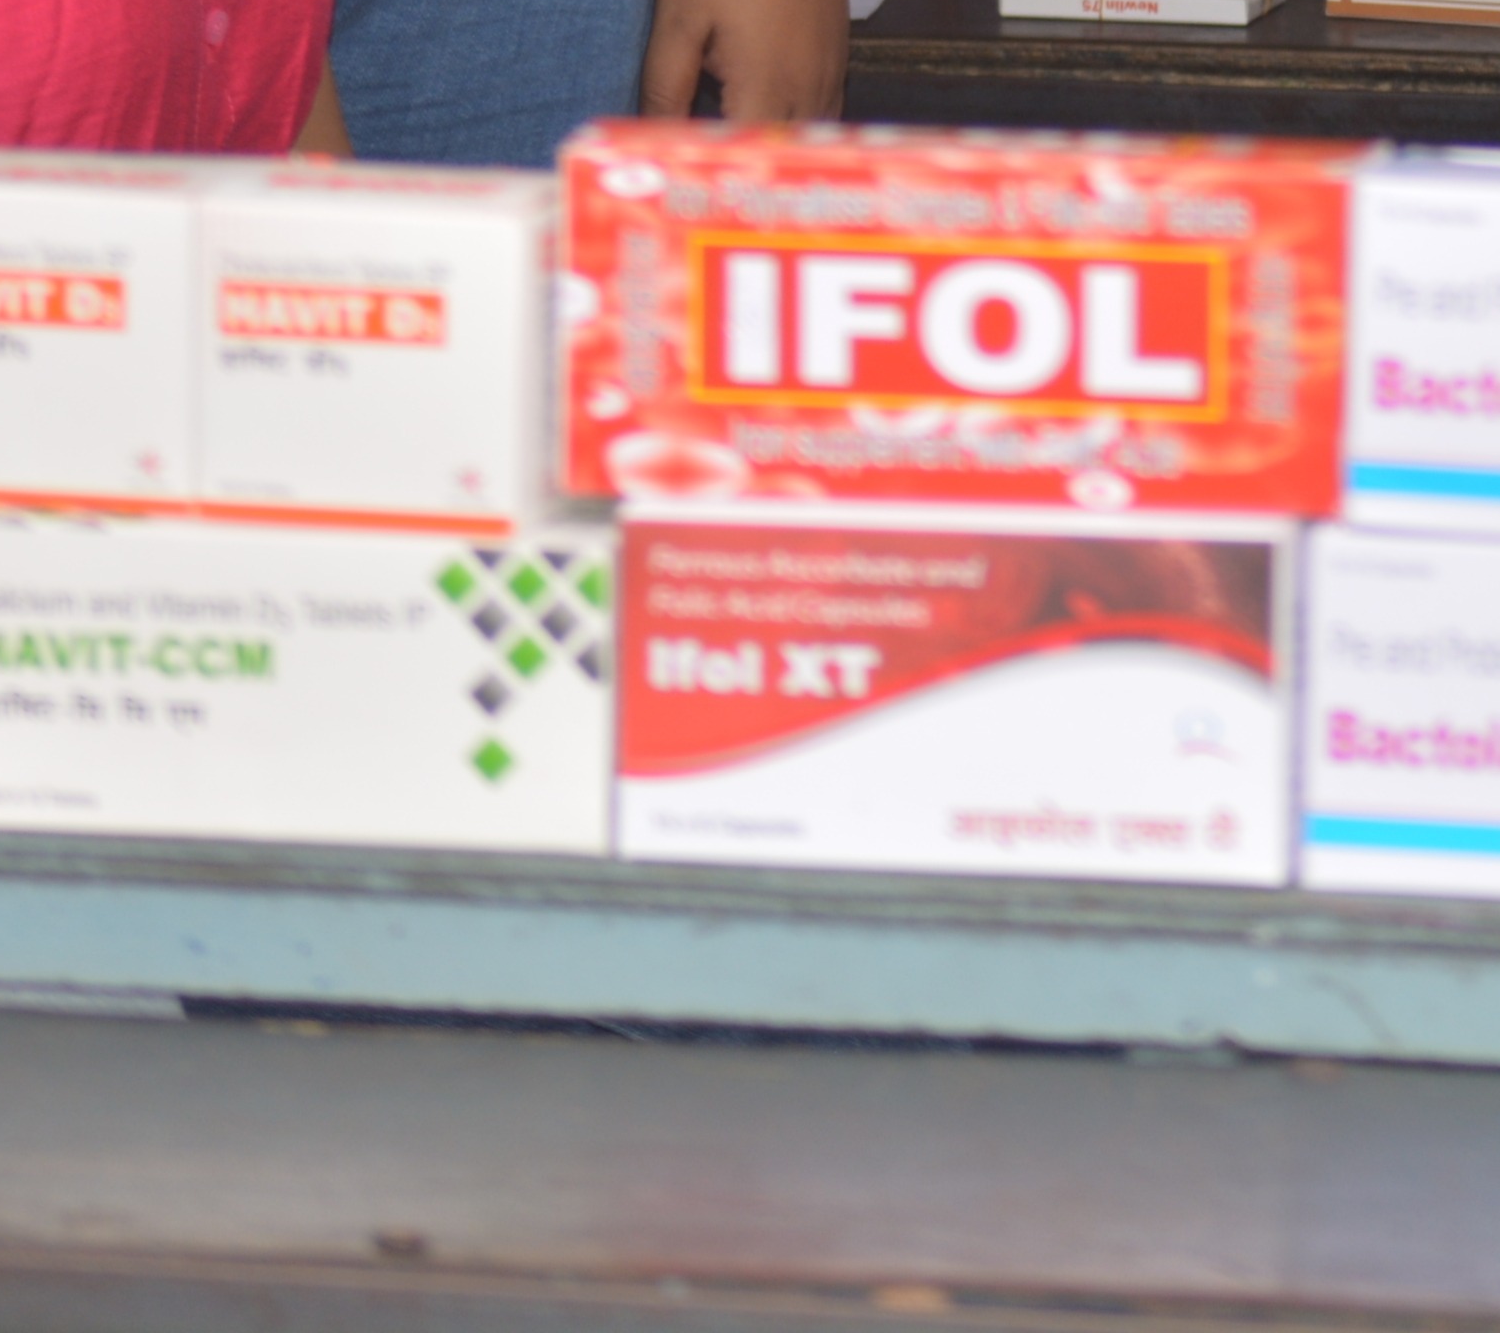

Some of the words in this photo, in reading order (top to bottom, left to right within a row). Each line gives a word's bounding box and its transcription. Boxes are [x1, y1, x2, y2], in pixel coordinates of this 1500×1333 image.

[1081, 0, 1101, 12] 75
[1105, 0, 1159, 14] Newlin
[721, 250, 1205, 401] IFOL
[923, 554, 989, 590] and
[644, 635, 765, 695] Ifol
[778, 642, 885, 701] XT
